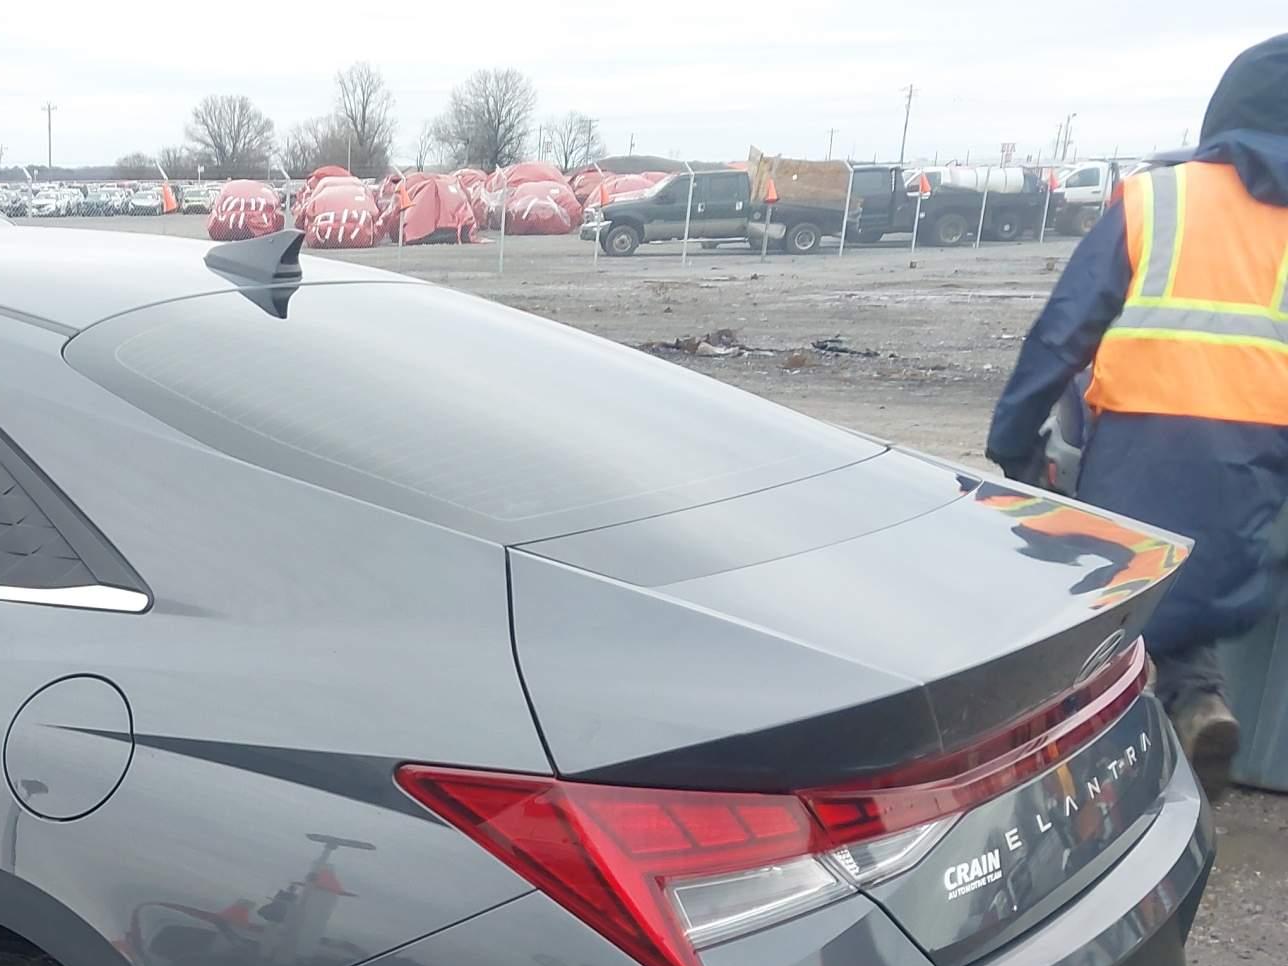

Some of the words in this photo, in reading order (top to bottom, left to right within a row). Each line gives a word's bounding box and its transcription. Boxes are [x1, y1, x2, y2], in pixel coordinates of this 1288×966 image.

[1004, 731, 1152, 851] ELANTRA
[944, 848, 1001, 891] CRAIN
[948, 877, 987, 900] AUTOMOTIVE
[987, 870, 1003, 883] TEAM
